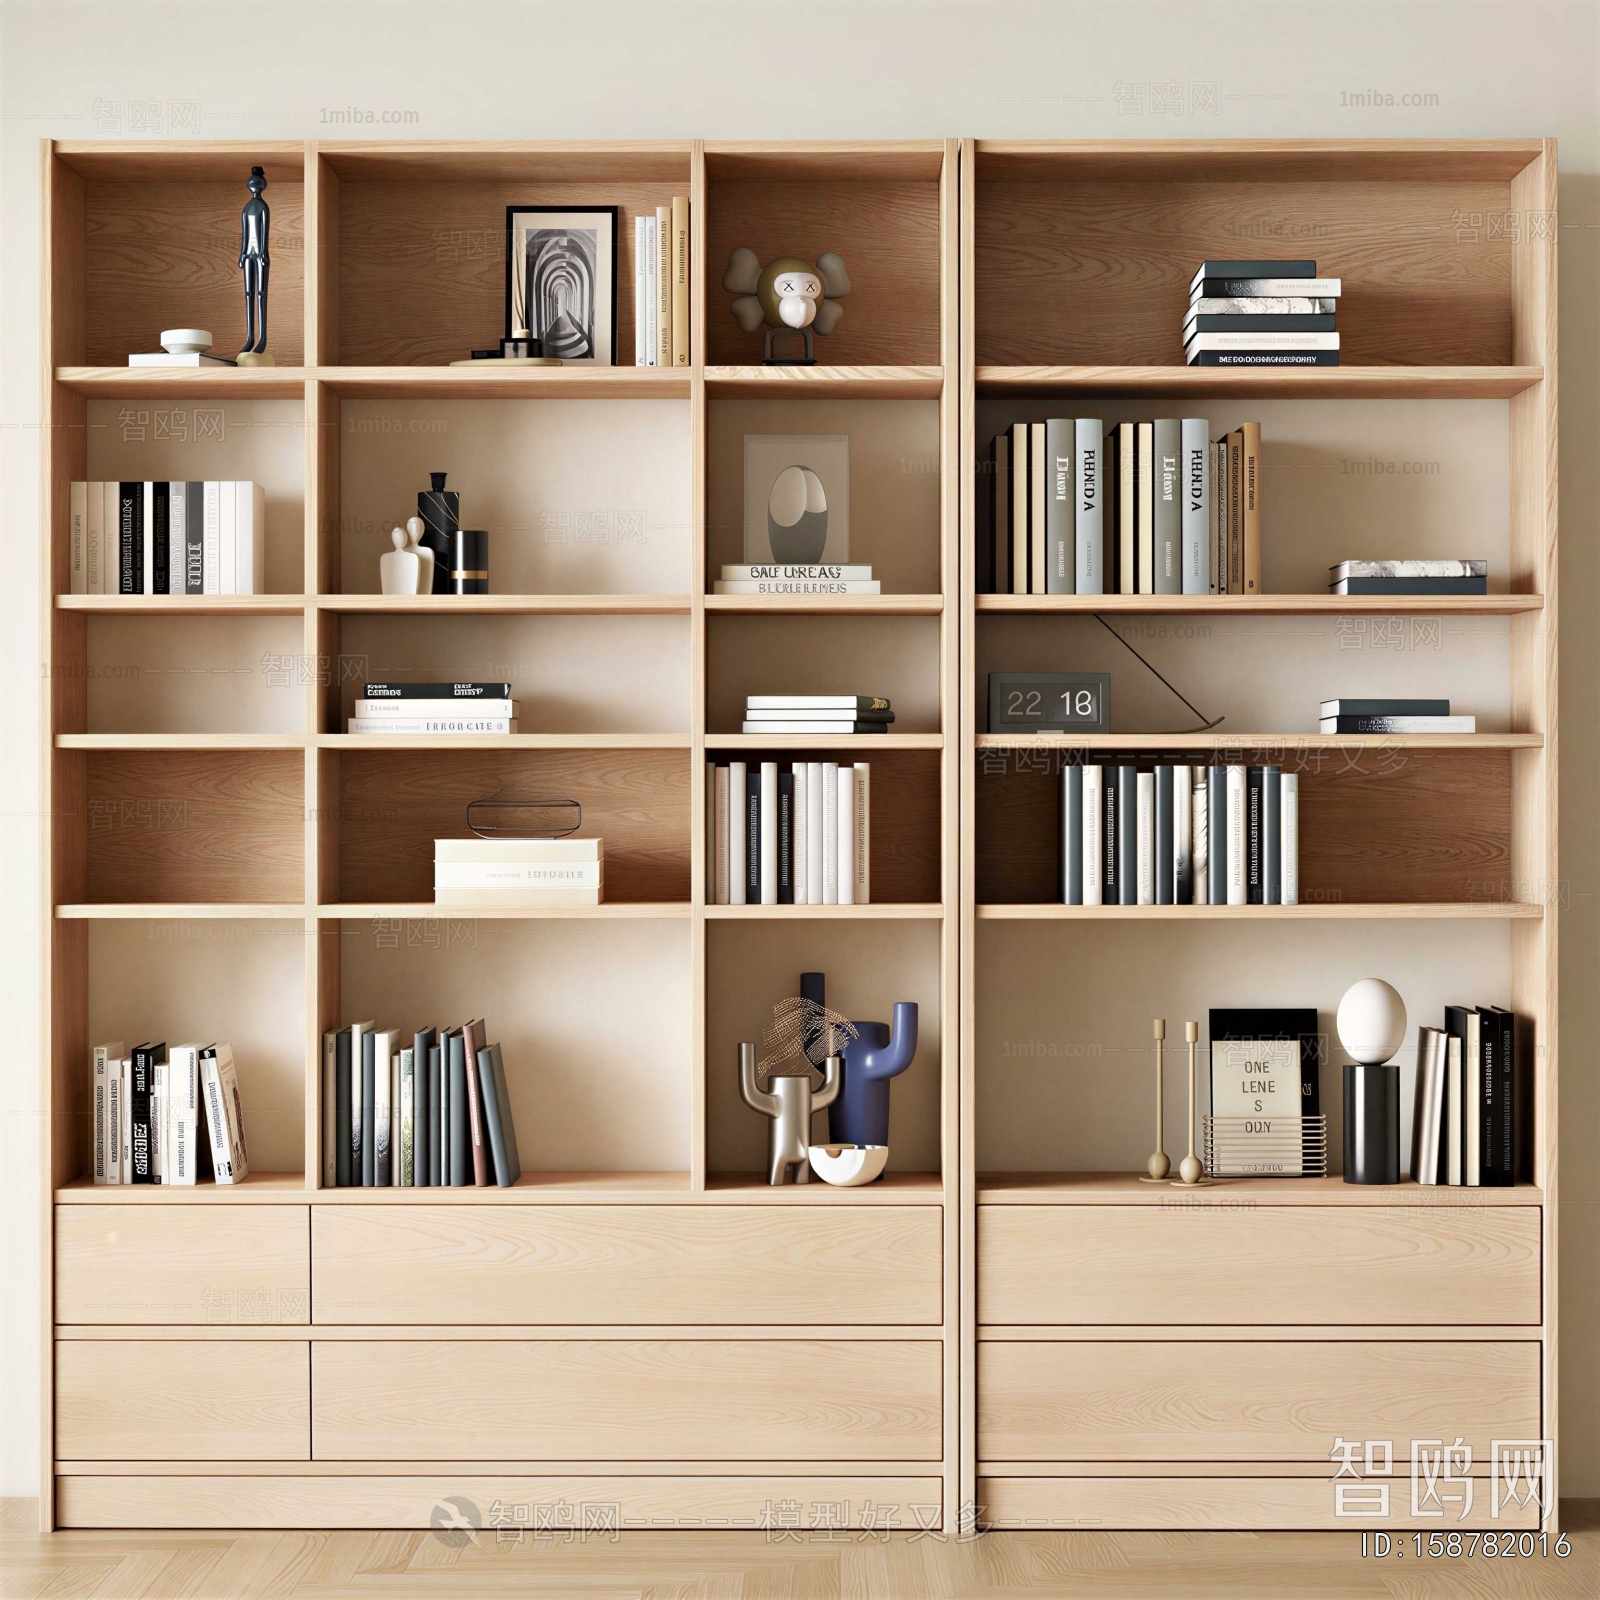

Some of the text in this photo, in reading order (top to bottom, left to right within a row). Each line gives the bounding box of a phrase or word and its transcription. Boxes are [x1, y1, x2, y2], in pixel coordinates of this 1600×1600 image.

[1007, 691, 1042, 716] 22
[1244, 1061, 1270, 1074] ONE
[1242, 1081, 1276, 1093] LENE
[1254, 1099, 1263, 1112] S
